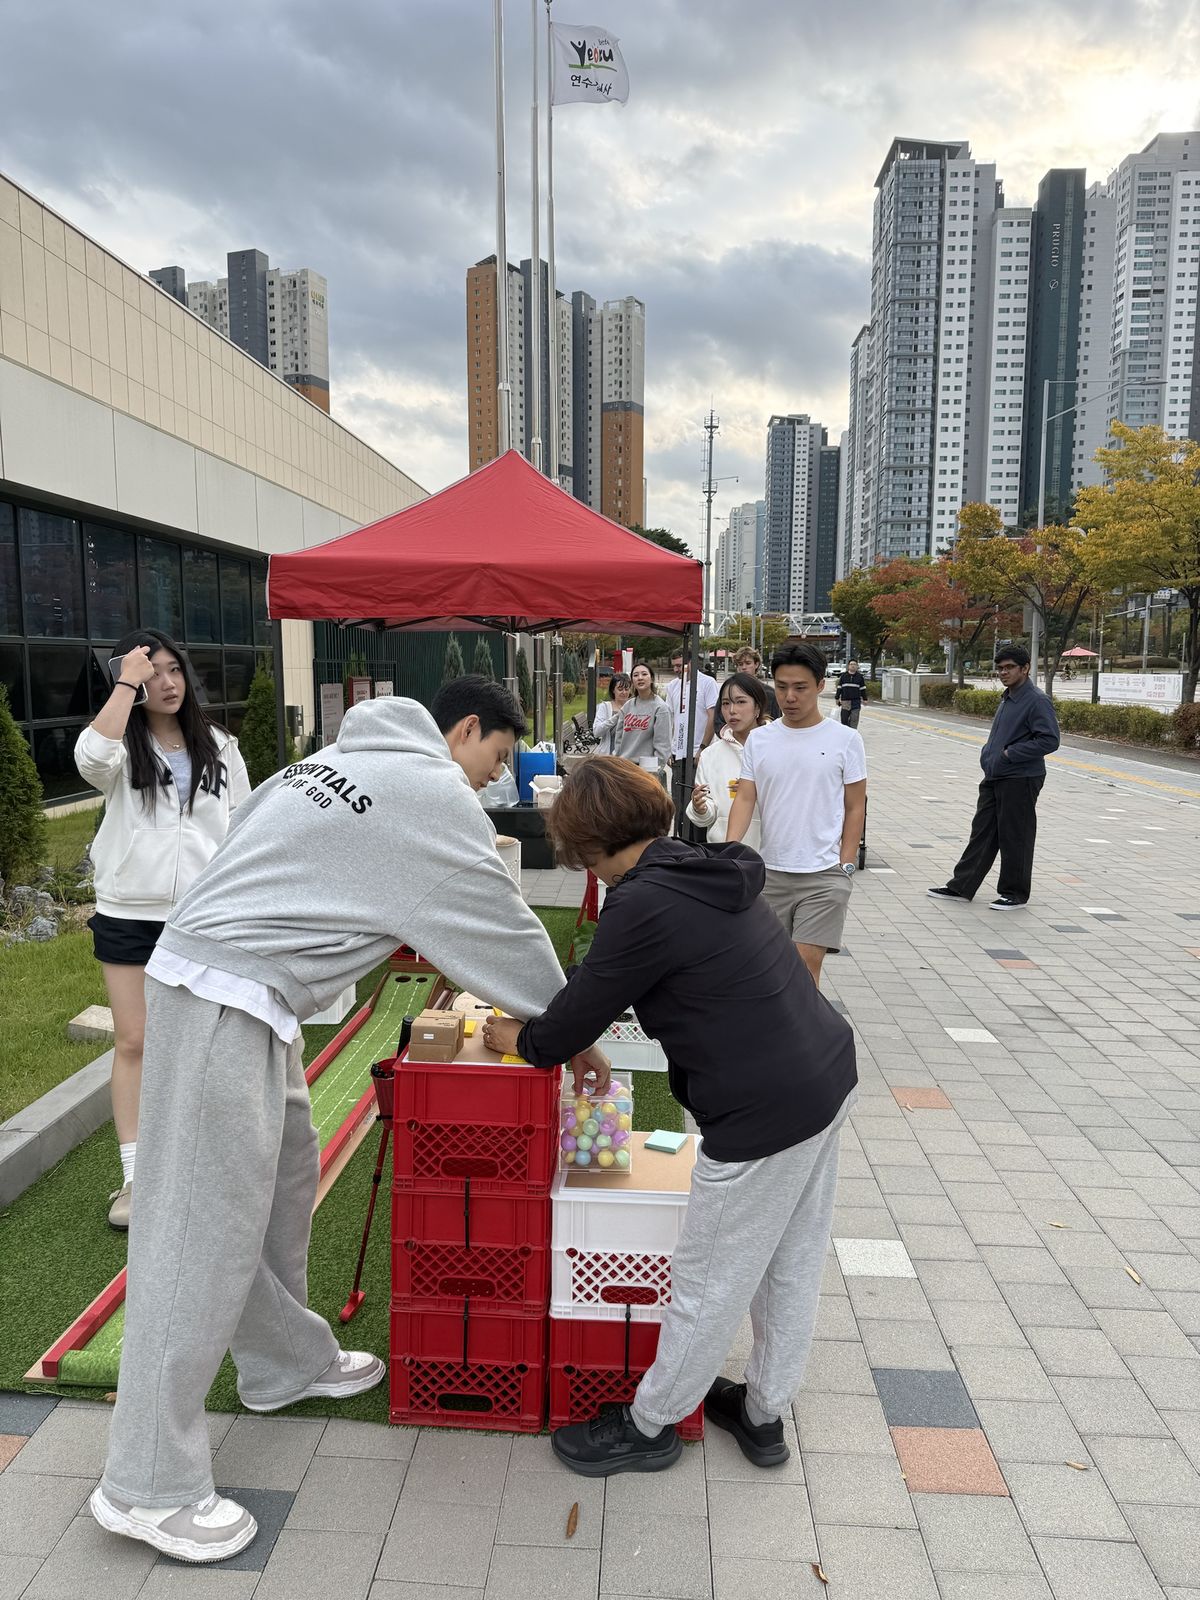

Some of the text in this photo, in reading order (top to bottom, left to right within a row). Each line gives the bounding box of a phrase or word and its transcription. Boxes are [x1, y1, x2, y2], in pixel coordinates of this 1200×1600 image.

[1051, 223, 1061, 267] PRUGIO
[624, 712, 651, 728] Utah
[282, 763, 373, 815] ESSENTIALS
[305, 786, 333, 809] GOD
